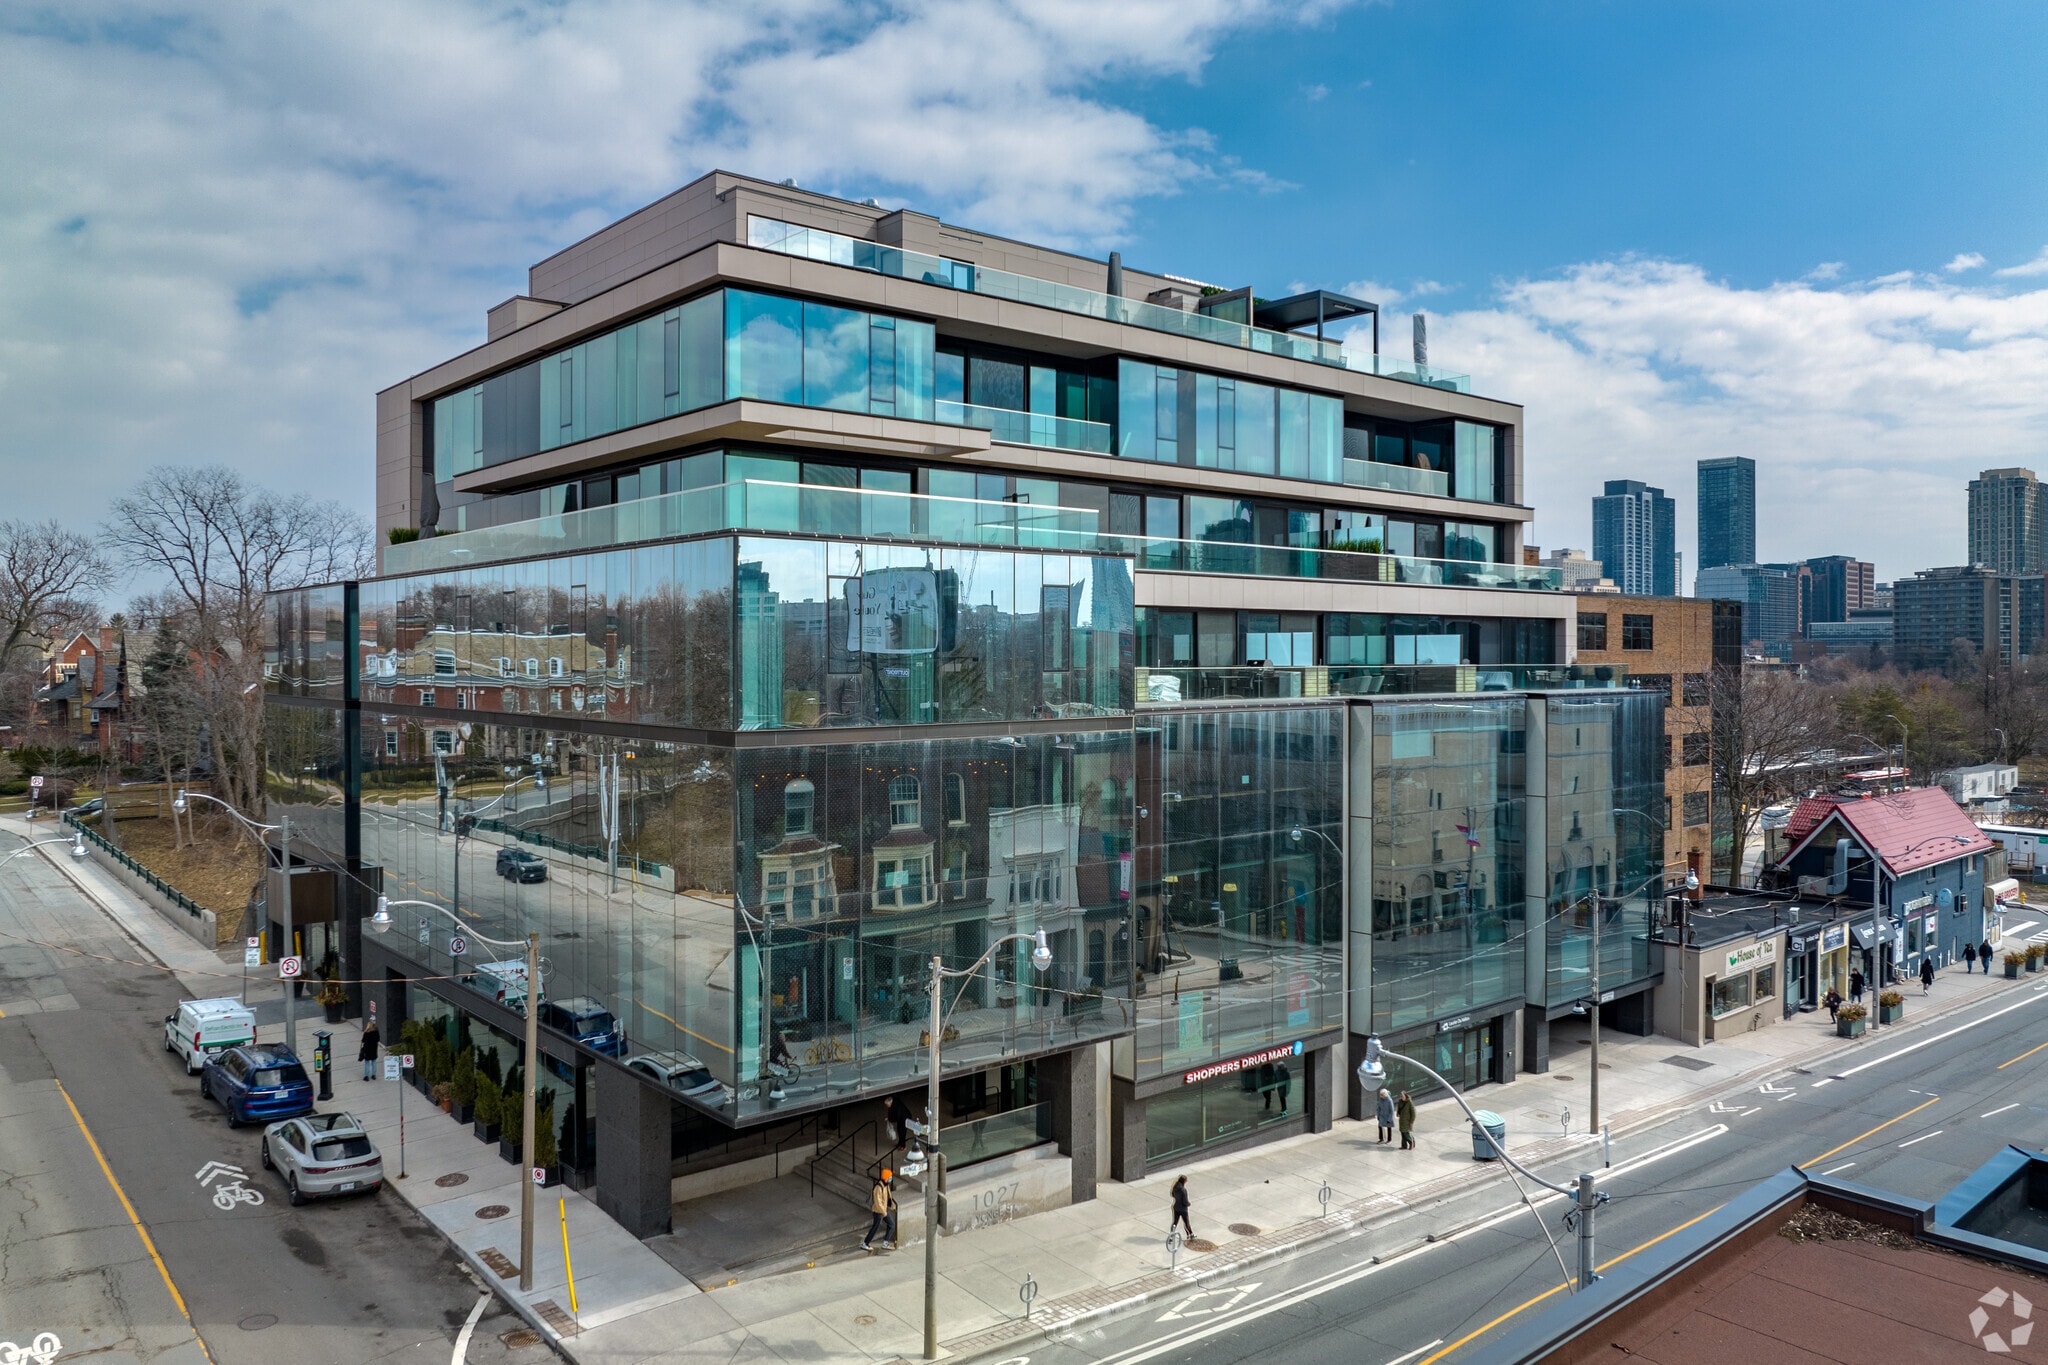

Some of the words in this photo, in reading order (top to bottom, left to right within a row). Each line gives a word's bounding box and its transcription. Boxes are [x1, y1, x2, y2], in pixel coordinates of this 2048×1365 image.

[1737, 949, 1755, 963] House
[1756, 942, 1762, 958] of
[1763, 941, 1773, 954] Tea
[1186, 1060, 1240, 1083] SHOPPERS
[1242, 1053, 1267, 1068] DRUG
[1268, 1045, 1294, 1061] MART
[973, 1181, 1019, 1211] 1027
